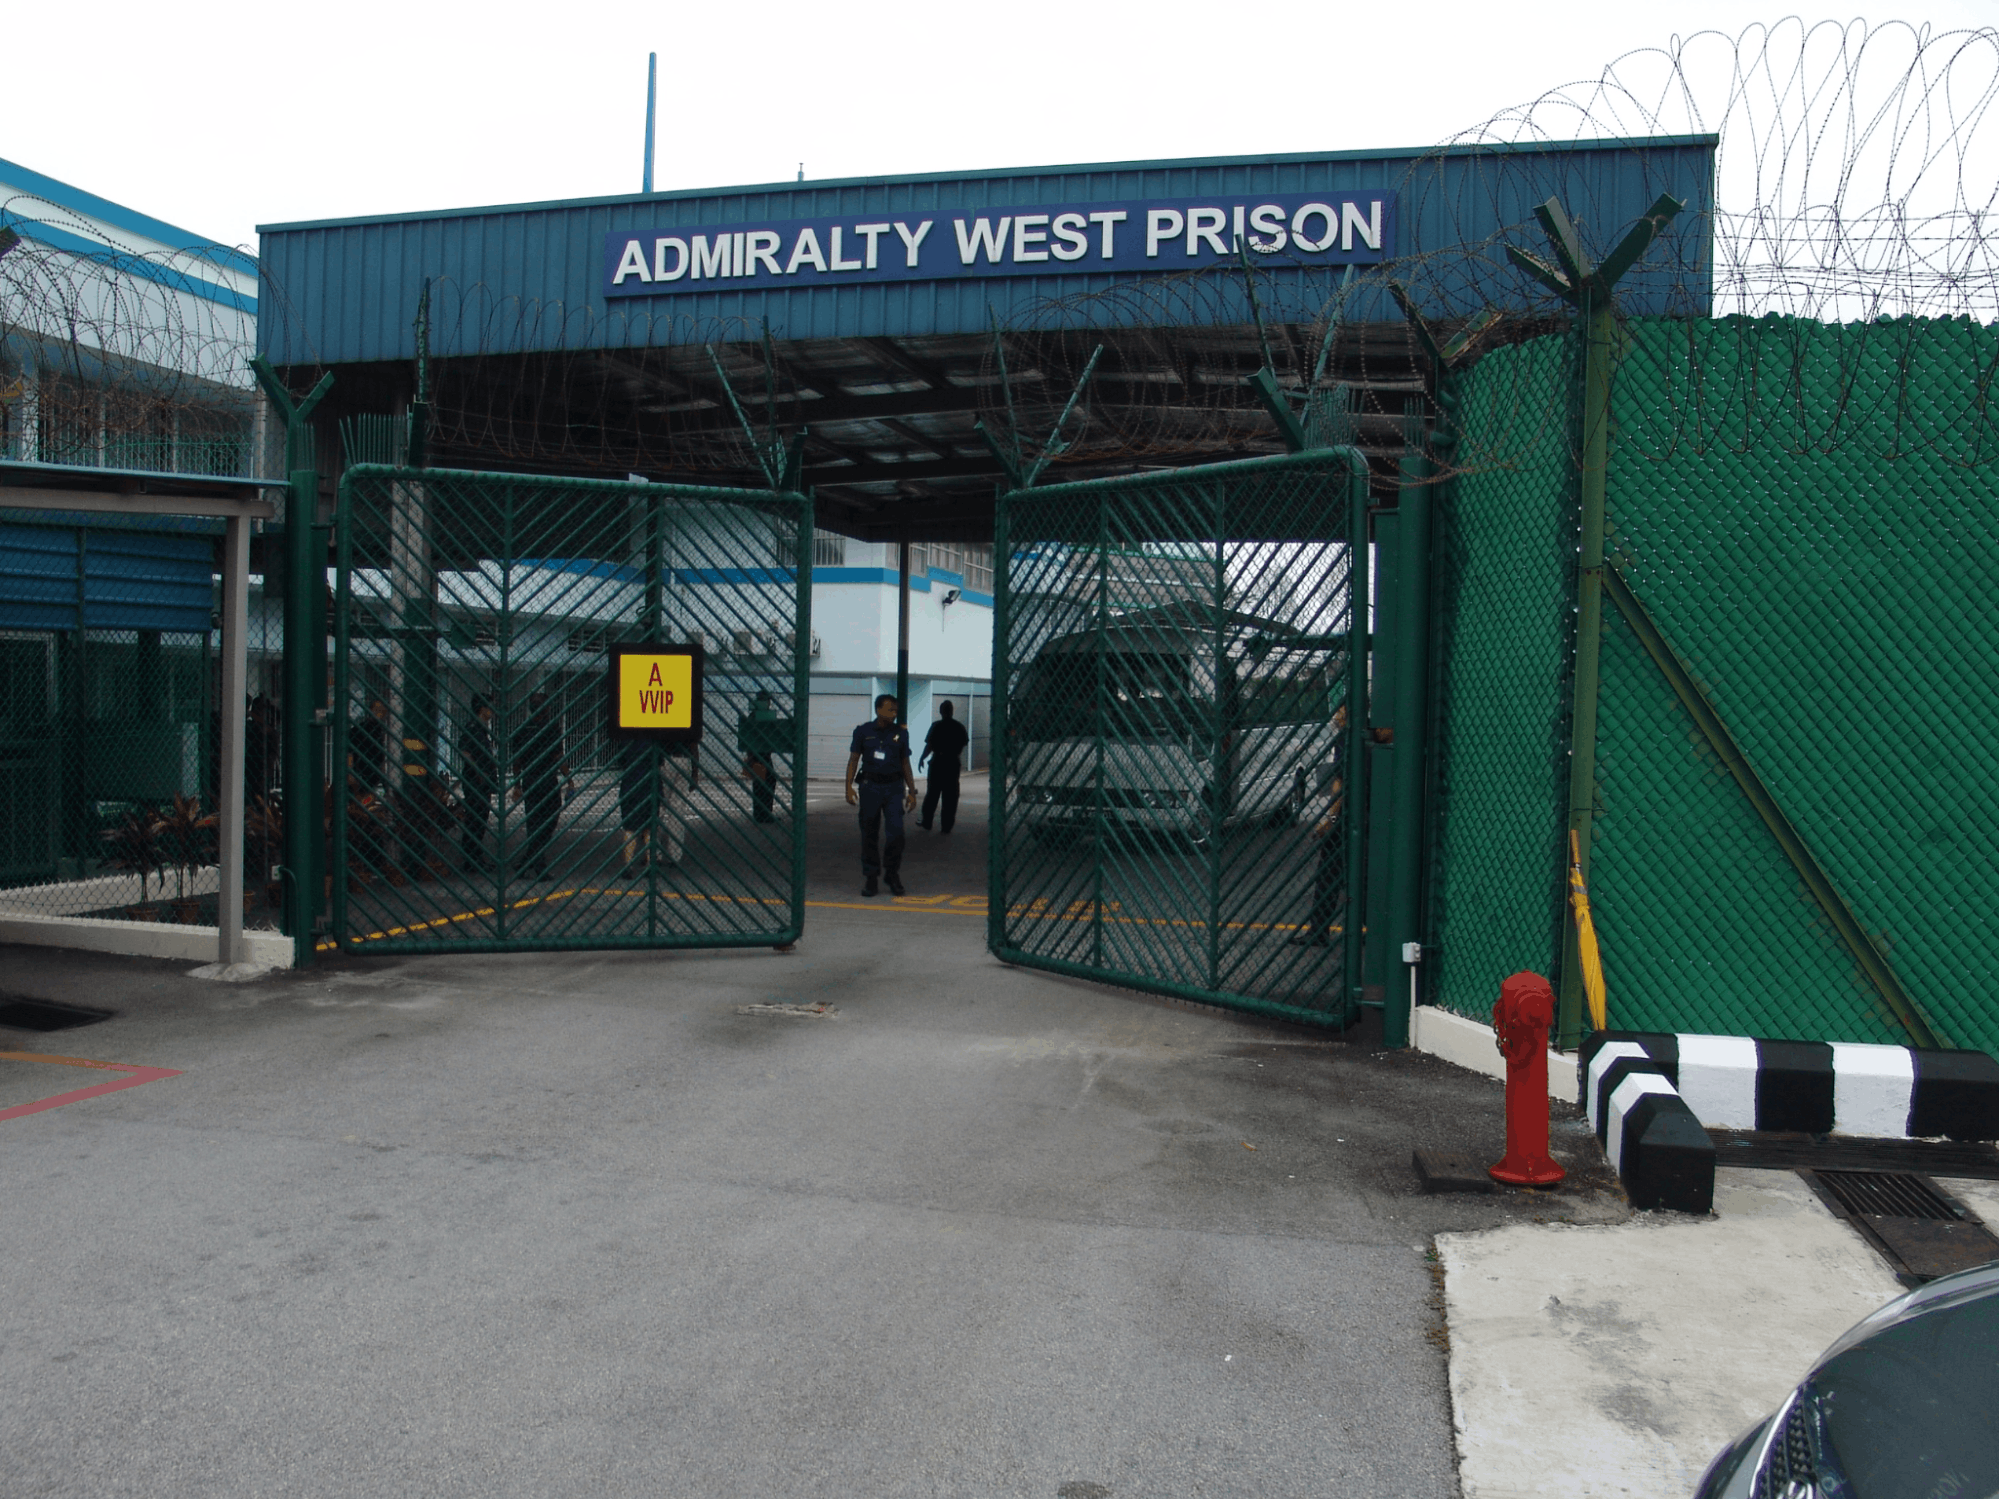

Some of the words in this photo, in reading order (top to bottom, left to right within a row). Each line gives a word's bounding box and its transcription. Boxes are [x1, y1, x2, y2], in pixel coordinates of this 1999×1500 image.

[613, 219, 934, 285] ADMIRALTY
[953, 209, 1128, 265] WEST
[1146, 200, 1383, 258] PRISON
[648, 662, 663, 687] A
[639, 689, 674, 714] VVIP
